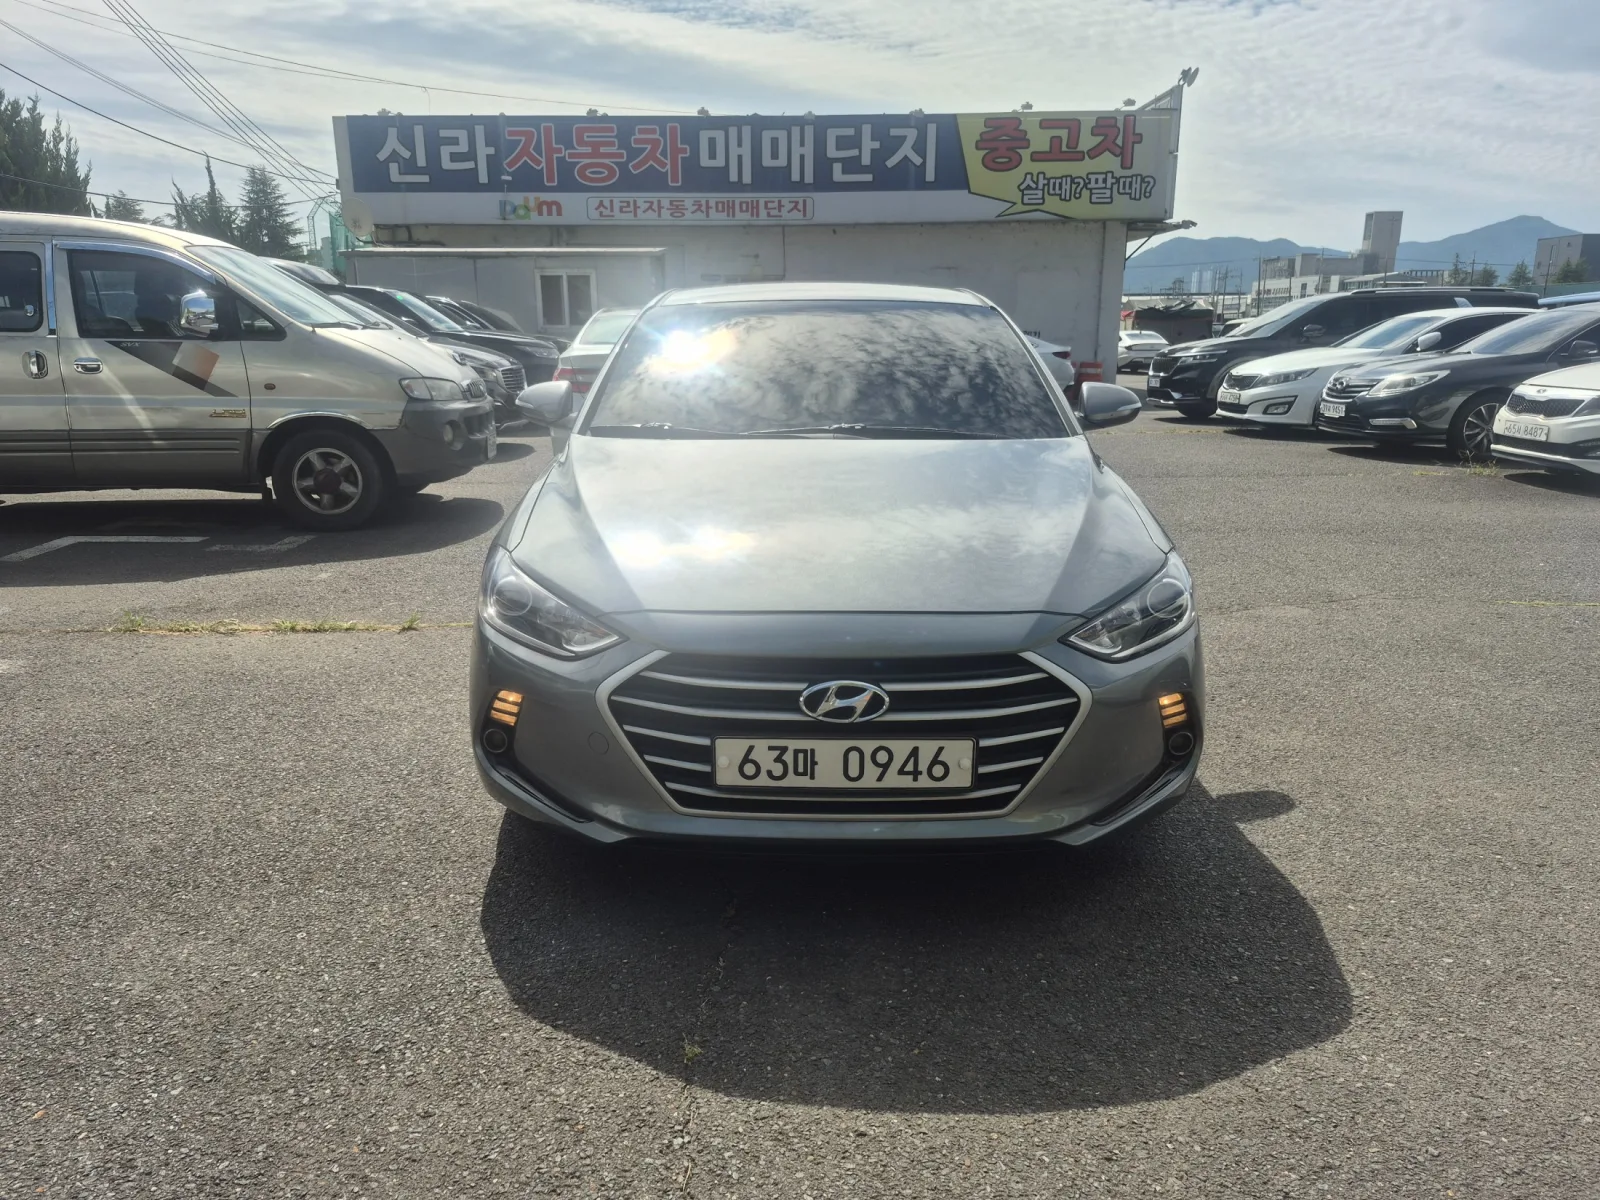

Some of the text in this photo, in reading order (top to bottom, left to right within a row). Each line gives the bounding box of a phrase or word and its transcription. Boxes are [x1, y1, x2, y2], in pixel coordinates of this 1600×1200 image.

[376, 122, 937, 185] 신라자동차매매단지
[975, 114, 1143, 172] 중고차
[594, 198, 808, 219] 신라자동차매매단지
[1524, 425, 1544, 438] 8487
[738, 745, 951, 782] 63마 0946
